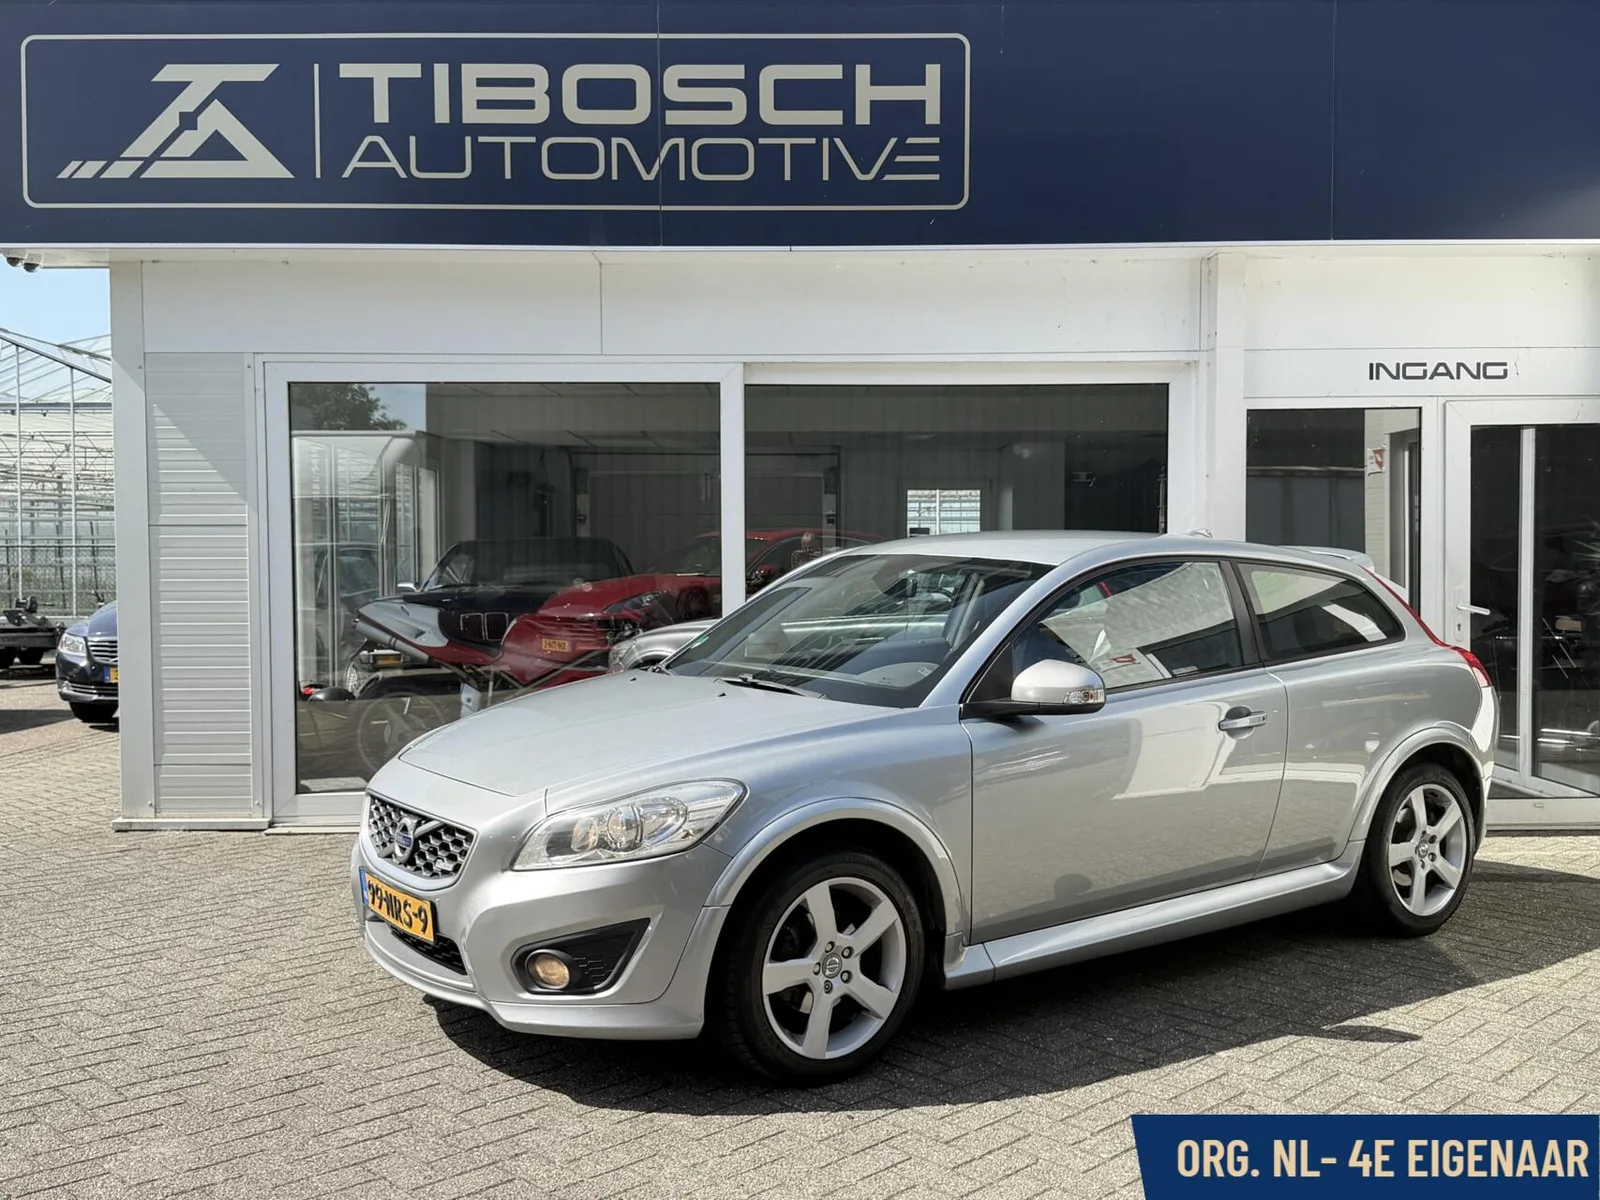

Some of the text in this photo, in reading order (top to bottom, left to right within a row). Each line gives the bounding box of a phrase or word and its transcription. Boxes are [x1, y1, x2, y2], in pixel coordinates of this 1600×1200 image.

[339, 63, 941, 125] TIBOSCH
[342, 136, 940, 181] AUTOMOTIVE
[1368, 361, 1508, 381] INGANG
[367, 880, 428, 935] 99-NRS-9
